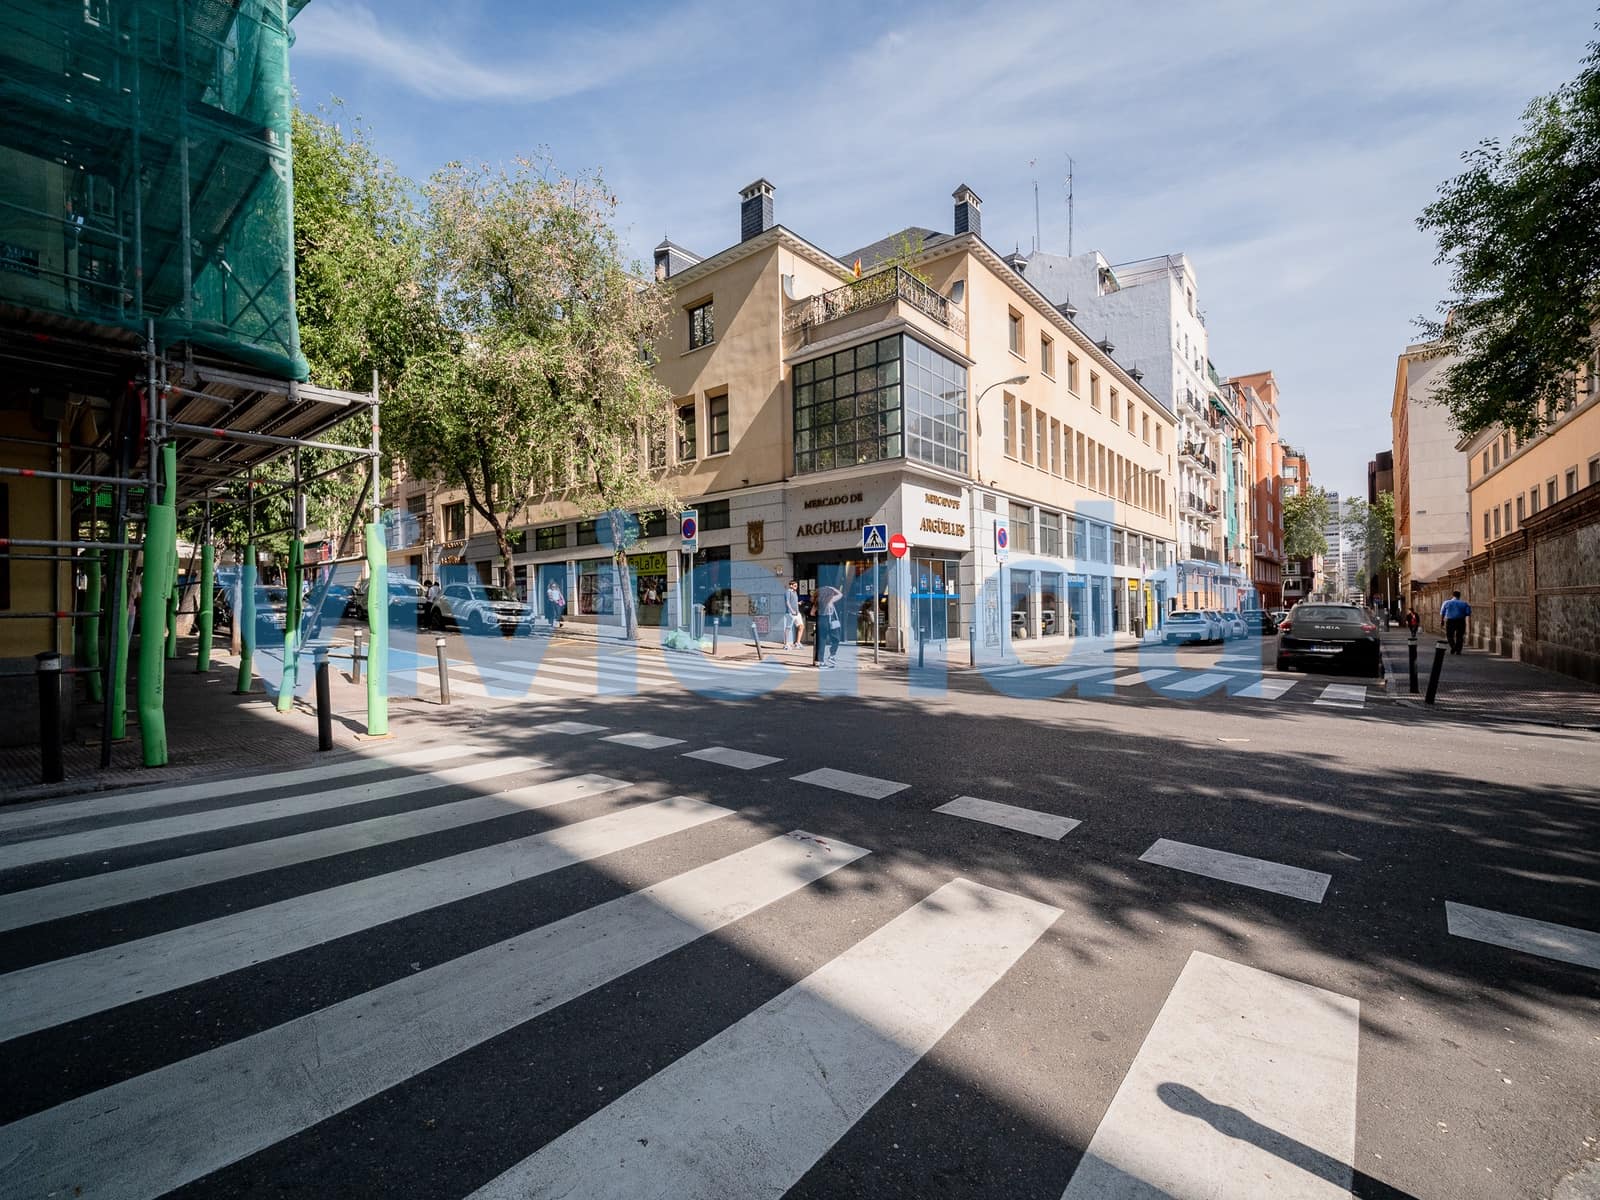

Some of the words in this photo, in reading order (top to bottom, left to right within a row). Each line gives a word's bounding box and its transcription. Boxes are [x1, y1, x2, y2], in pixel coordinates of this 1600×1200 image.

[804, 494, 849, 509] MERCADO
[850, 493, 863, 503] DE
[919, 517, 966, 537] ARGÜELLES
